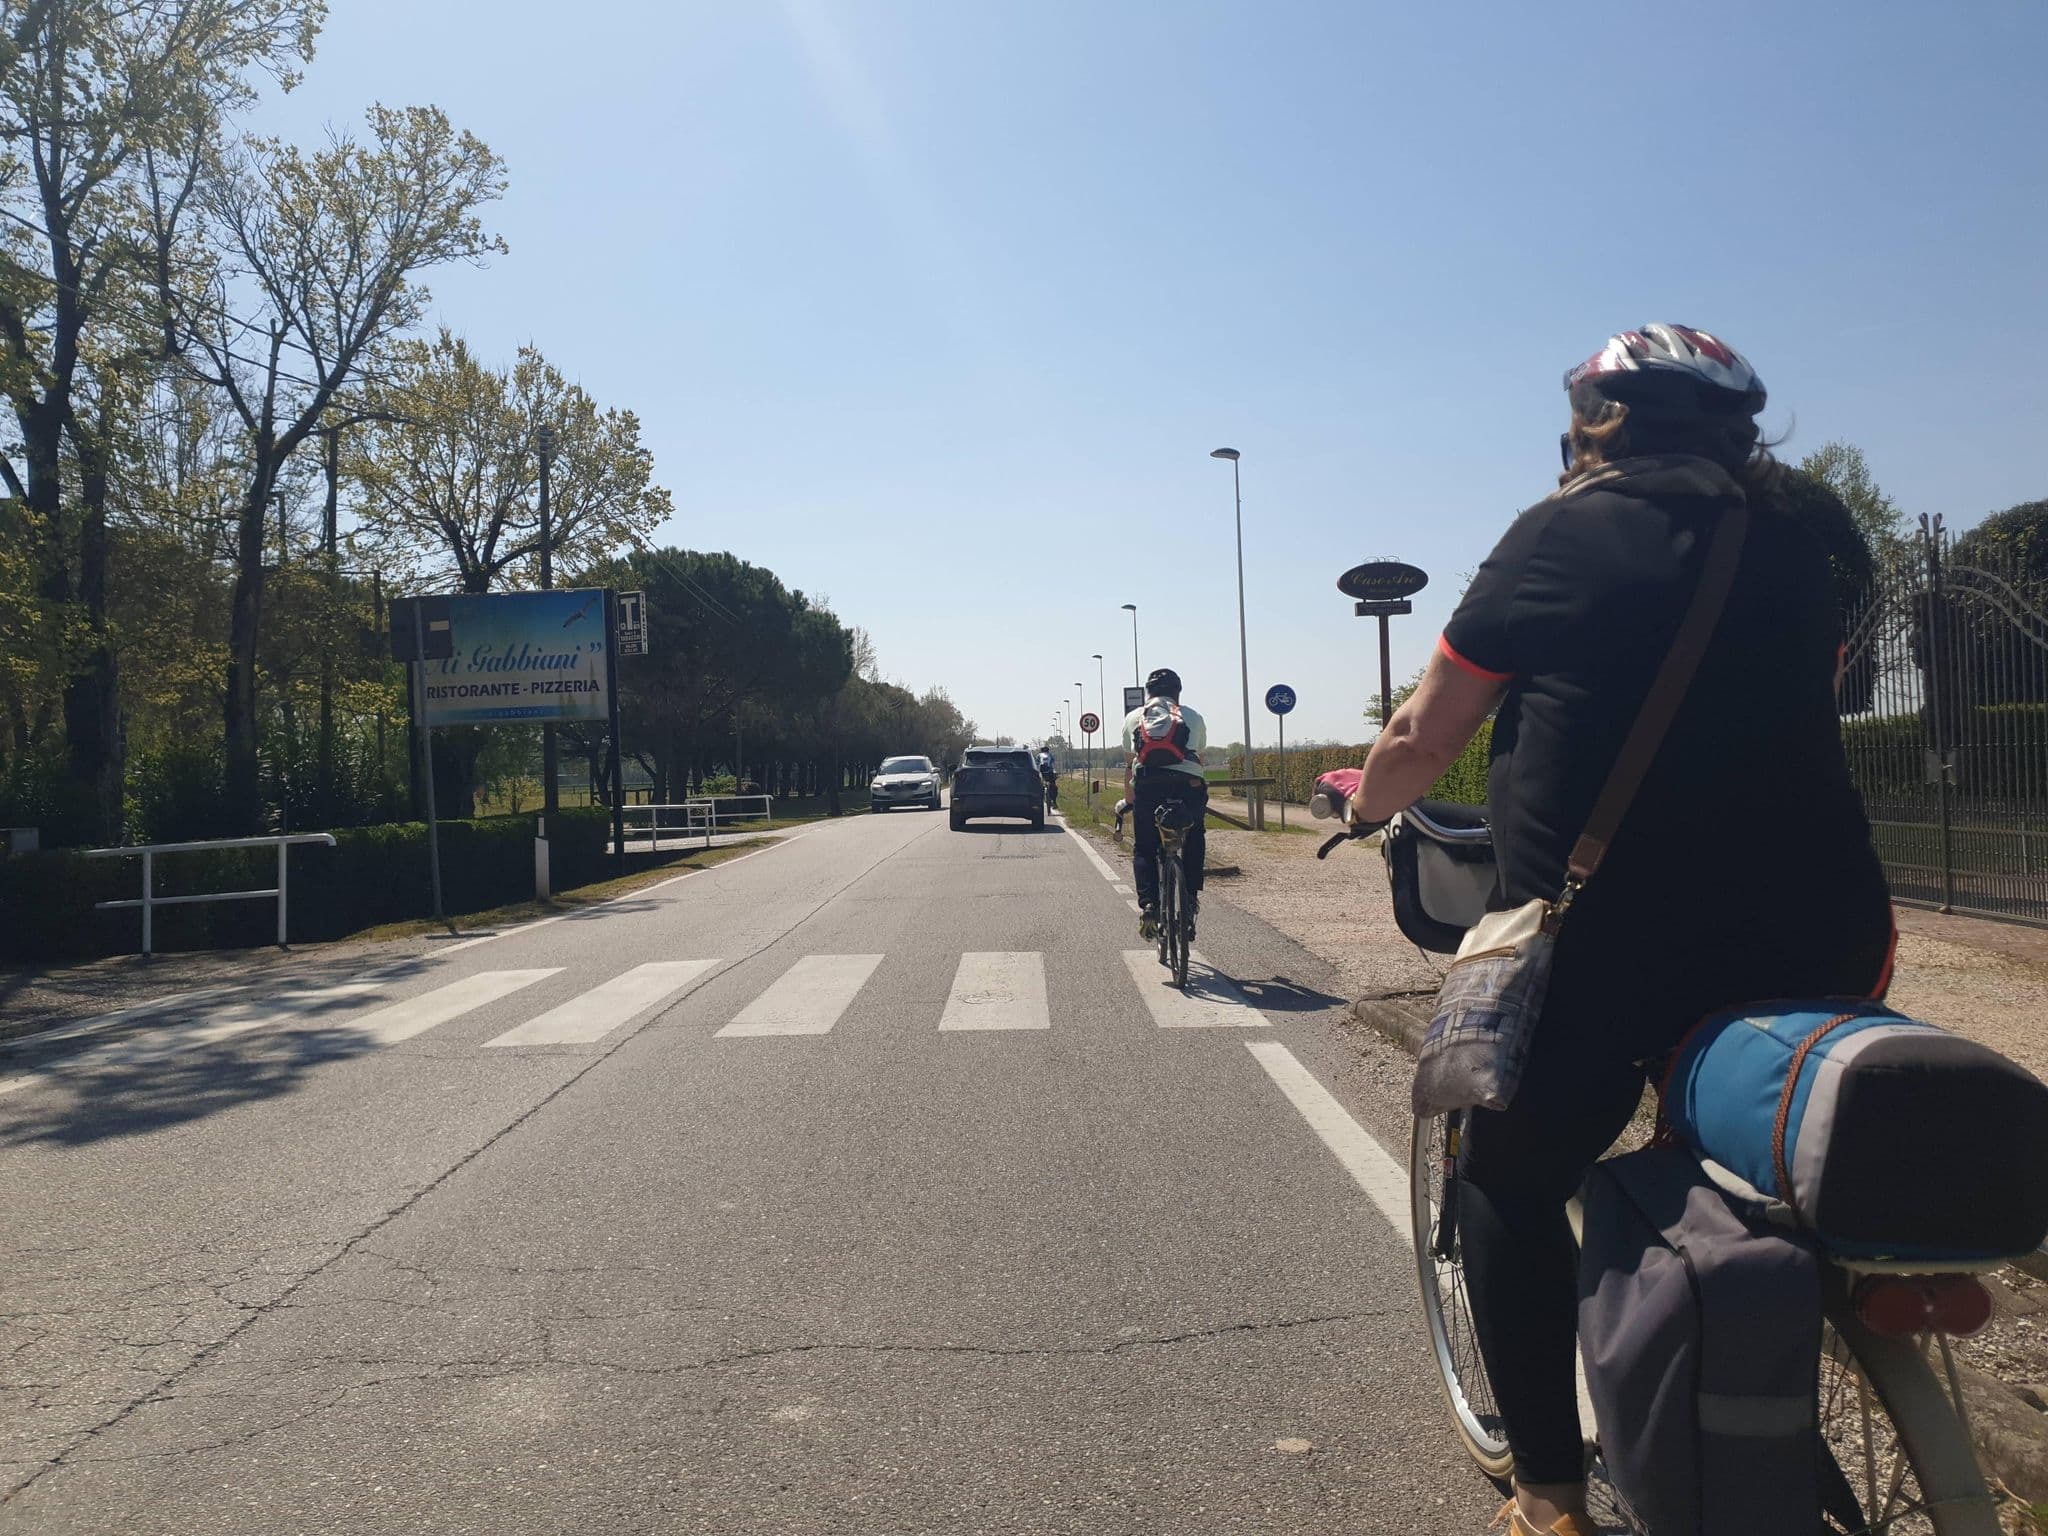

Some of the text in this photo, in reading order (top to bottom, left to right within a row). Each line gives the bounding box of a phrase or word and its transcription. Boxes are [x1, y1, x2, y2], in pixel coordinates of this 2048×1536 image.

[427, 682, 520, 699] RISTORANTE
[531, 680, 600, 694] PIZZERIA
[1084, 718, 1096, 728] 50
